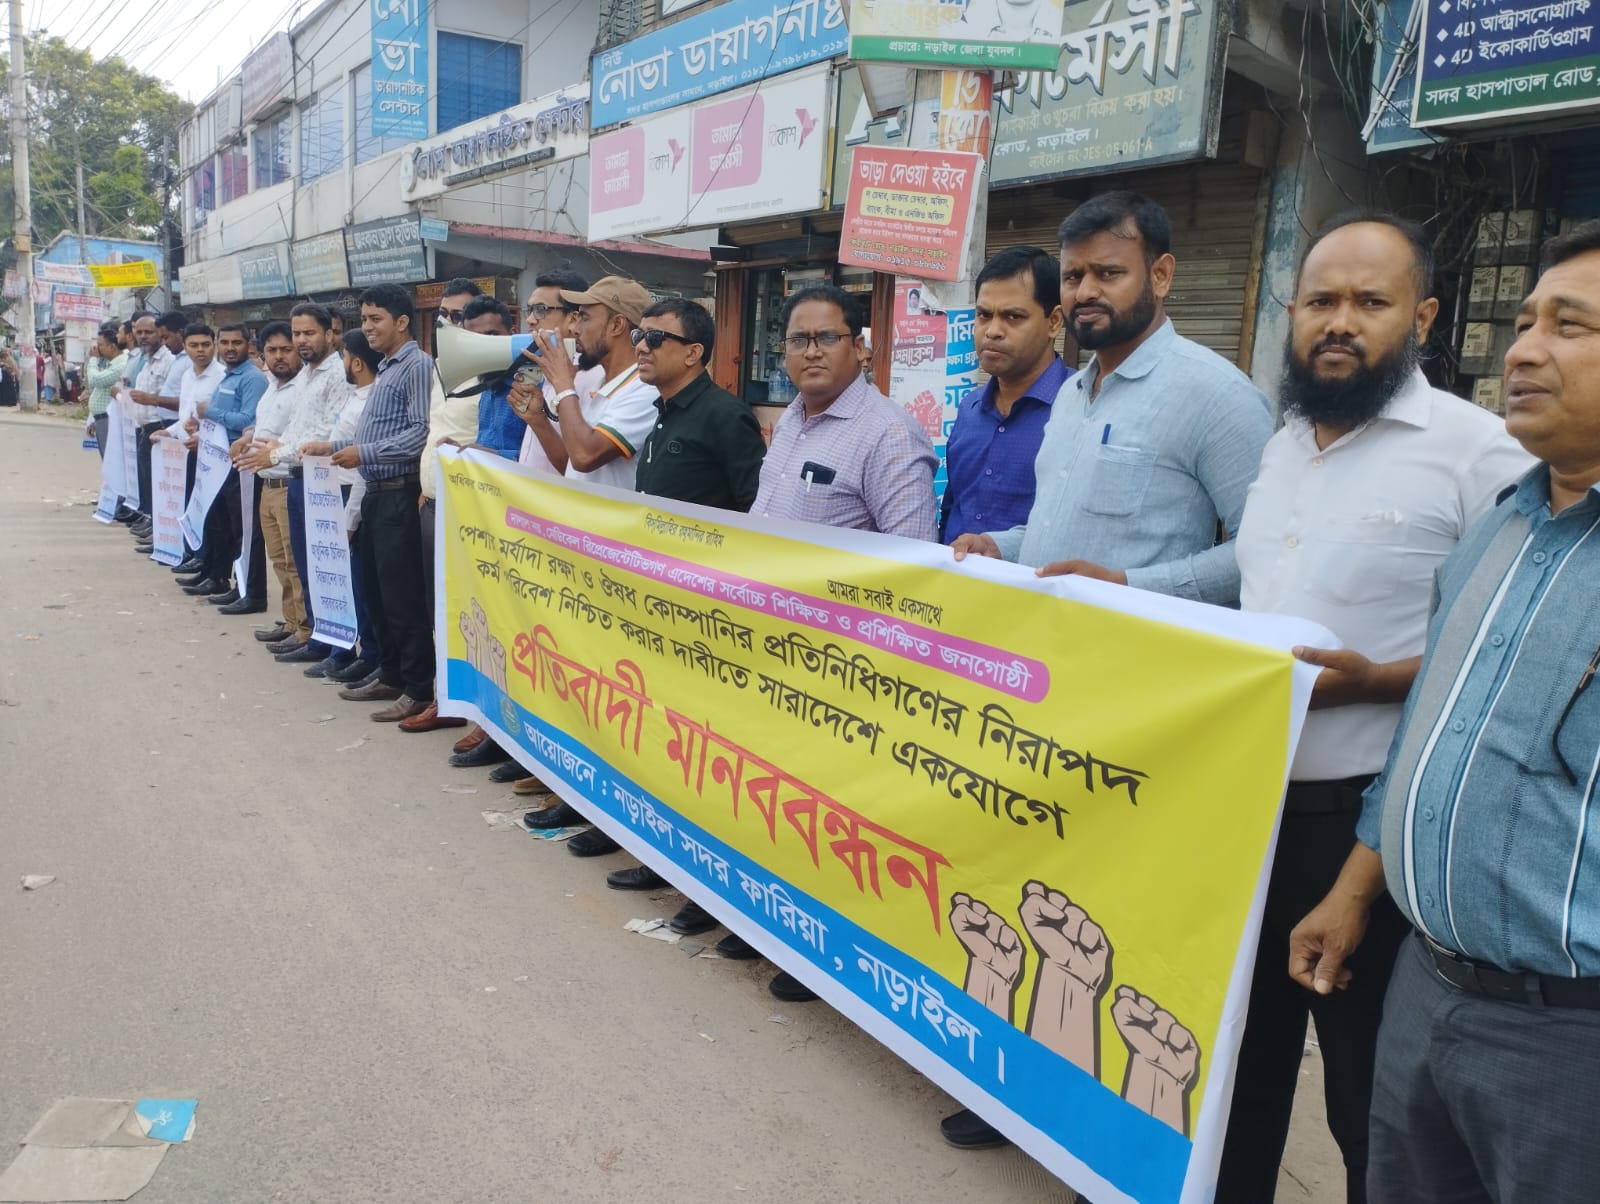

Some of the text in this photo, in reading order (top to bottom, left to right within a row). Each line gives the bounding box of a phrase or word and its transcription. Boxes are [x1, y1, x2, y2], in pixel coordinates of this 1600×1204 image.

[888, 41, 921, 53] প্রচারে:
[924, 42, 957, 55] নড়াইল
[960, 44, 984, 55] জেলা
[1450, 26, 1593, 65] 4D ইকোকার্ডিওগ্রাম
[1454, 21, 1476, 38] 4D
[375, 38, 421, 76] ভা
[599, 46, 674, 104] নোভা
[1124, 91, 1151, 111] করা
[1425, 86, 1462, 105] সদর
[1465, 73, 1549, 101] হাসপাতাল
[859, 159, 968, 191] ভাড়া দেওয়া হইবে
[827, 579, 944, 626] আমরা সবাই একসাথে
[668, 565, 716, 593] এদেশের
[719, 580, 766, 608] সর্বোচ্চ
[771, 591, 830, 625] শিক্ষিত
[836, 614, 851, 631] ও
[857, 620, 933, 658] প্রশিক্ষিত
[937, 643, 1033, 693] জনগোষ্ঠী
[499, 537, 543, 570] মর্যাদা
[546, 552, 577, 584] রক্ষা
[583, 570, 594, 590] ও
[599, 567, 638, 610] ঔষধ
[645, 594, 755, 653] কোম্পানির
[763, 631, 970, 737] প্রতিনিধিগণের
[977, 702, 1152, 806] নিরাপদ
[558, 586, 613, 630] নিশ্চিত
[616, 615, 665, 656] করার
[669, 637, 752, 689] দাবীতে
[758, 672, 885, 756] সারাদেশে
[891, 740, 1071, 840] একযোগে
[511, 623, 954, 938] প্রতিবাদী মানববন্ধন
[523, 720, 597, 791] আয়োজনে
[611, 780, 675, 849] নড়াইল
[677, 828, 731, 889] সদর
[735, 866, 830, 955] ফারিয়া
[852, 943, 983, 1065] নড়াইল
